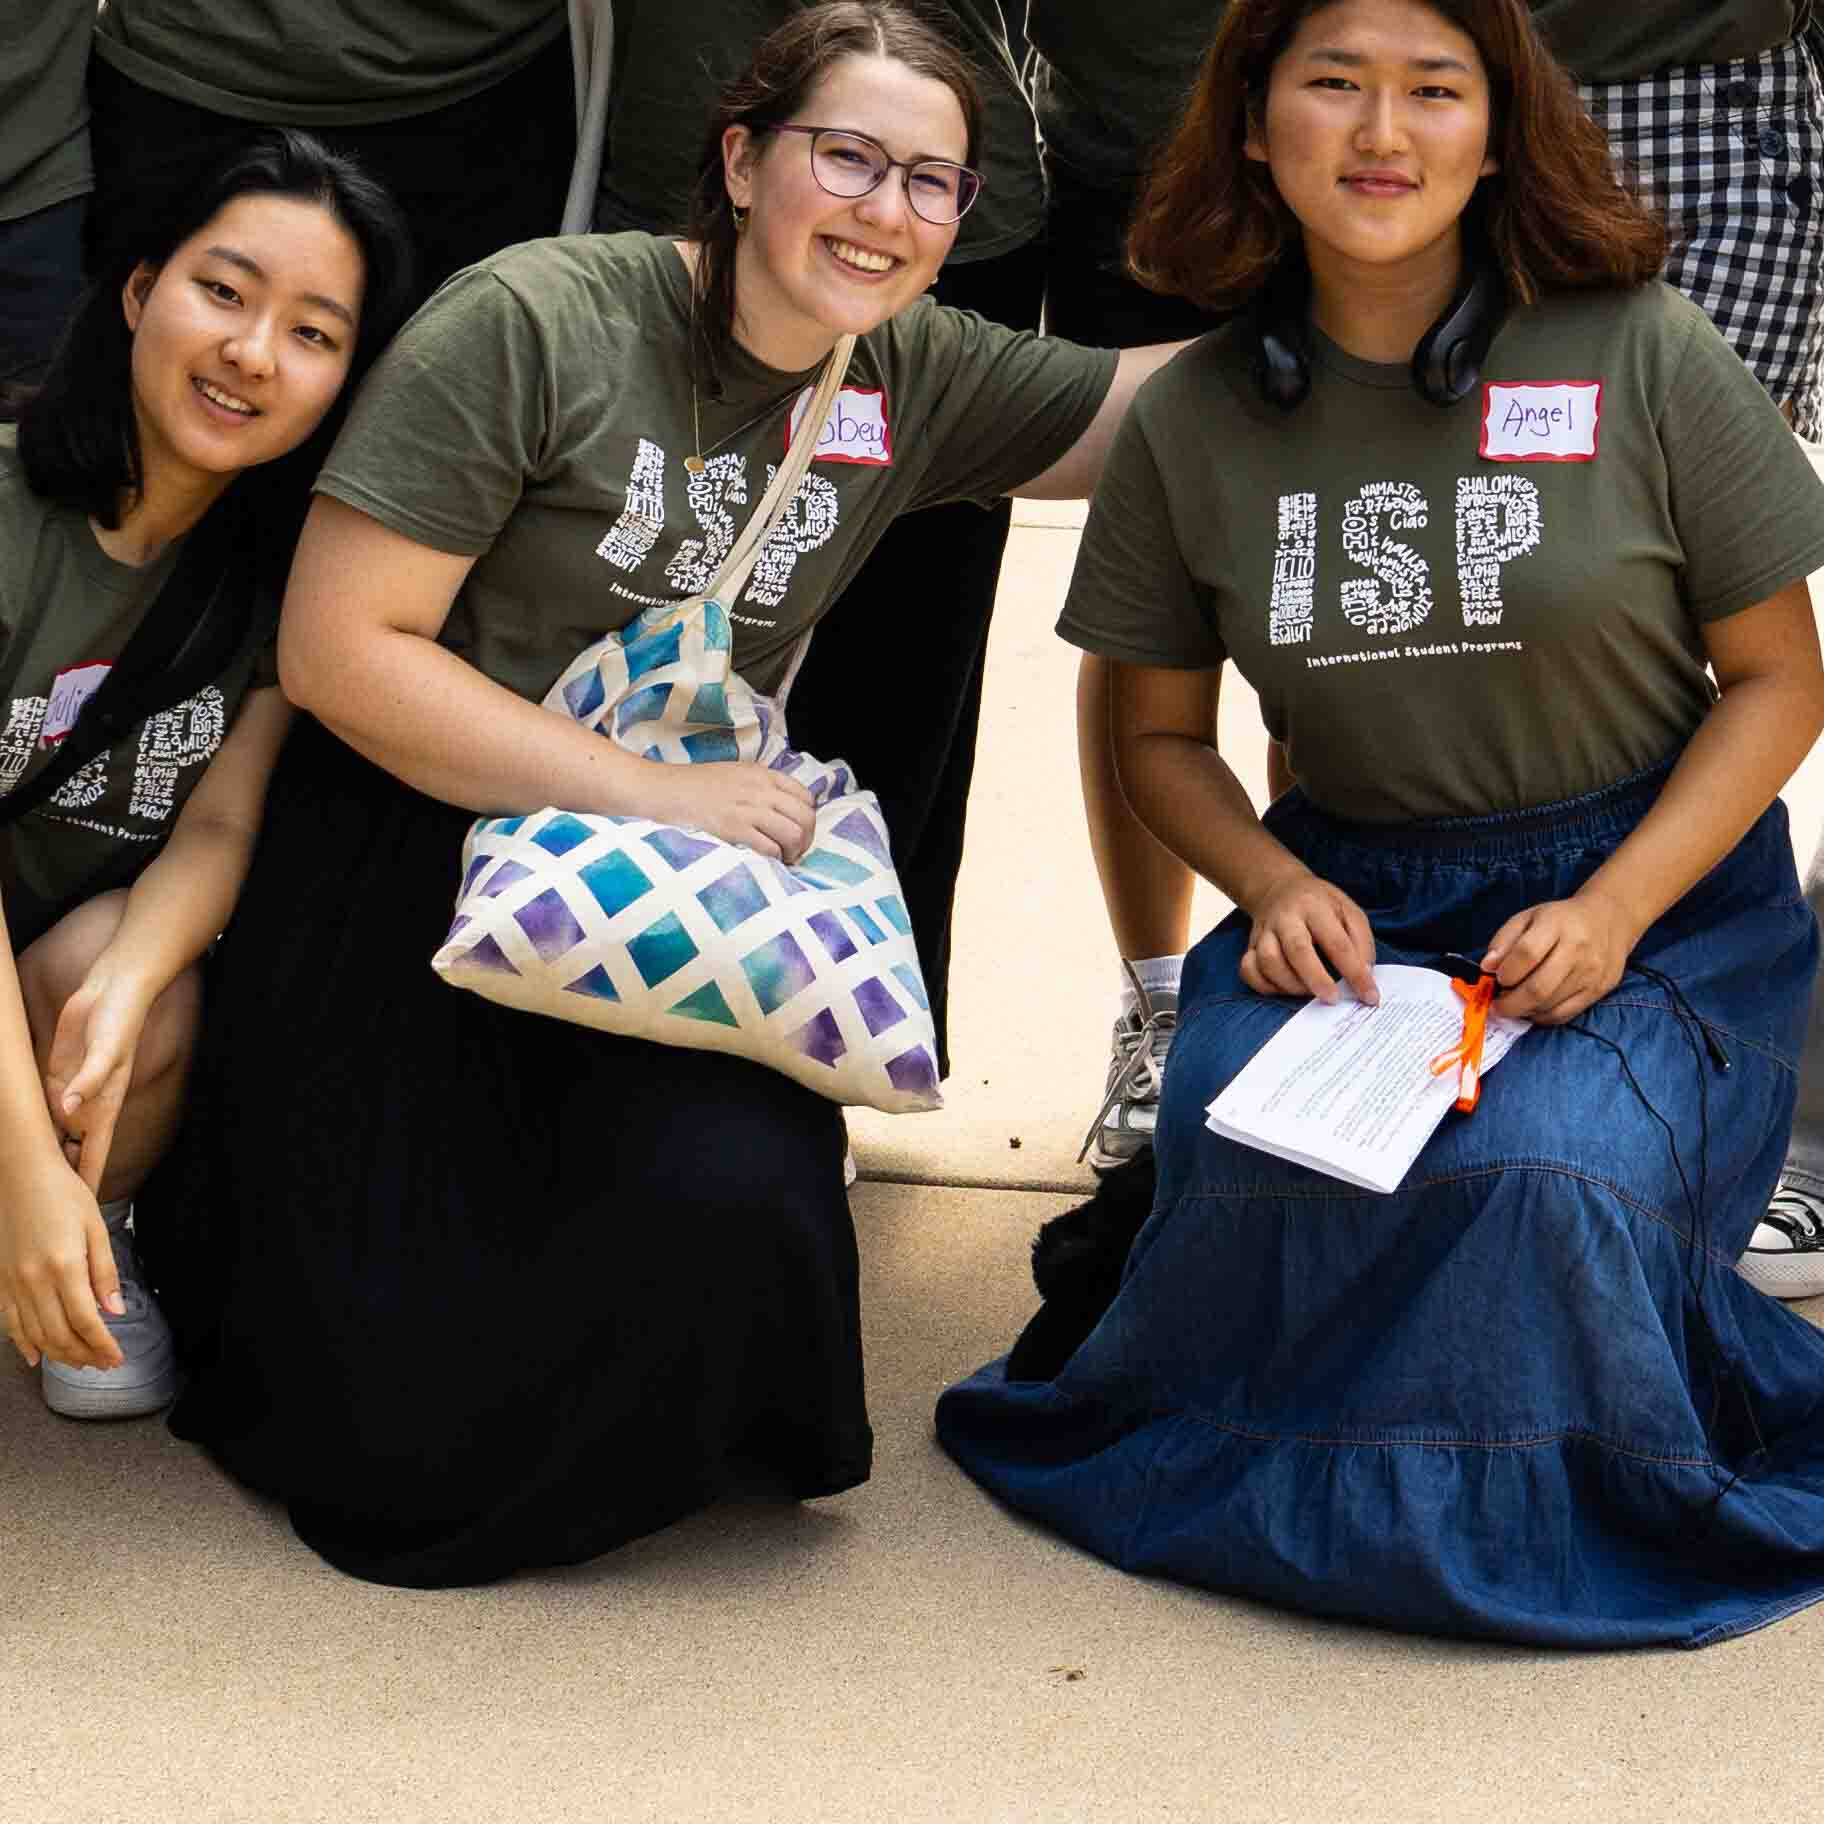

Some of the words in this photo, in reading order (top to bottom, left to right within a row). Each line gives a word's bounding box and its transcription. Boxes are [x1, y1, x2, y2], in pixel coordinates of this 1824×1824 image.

[1502, 397, 1573, 437] Angel
[1269, 474, 1545, 646] ISP
[1306, 649, 1400, 669] International
[1405, 644, 1459, 658] Student
[1462, 640, 1523, 654] Programs
